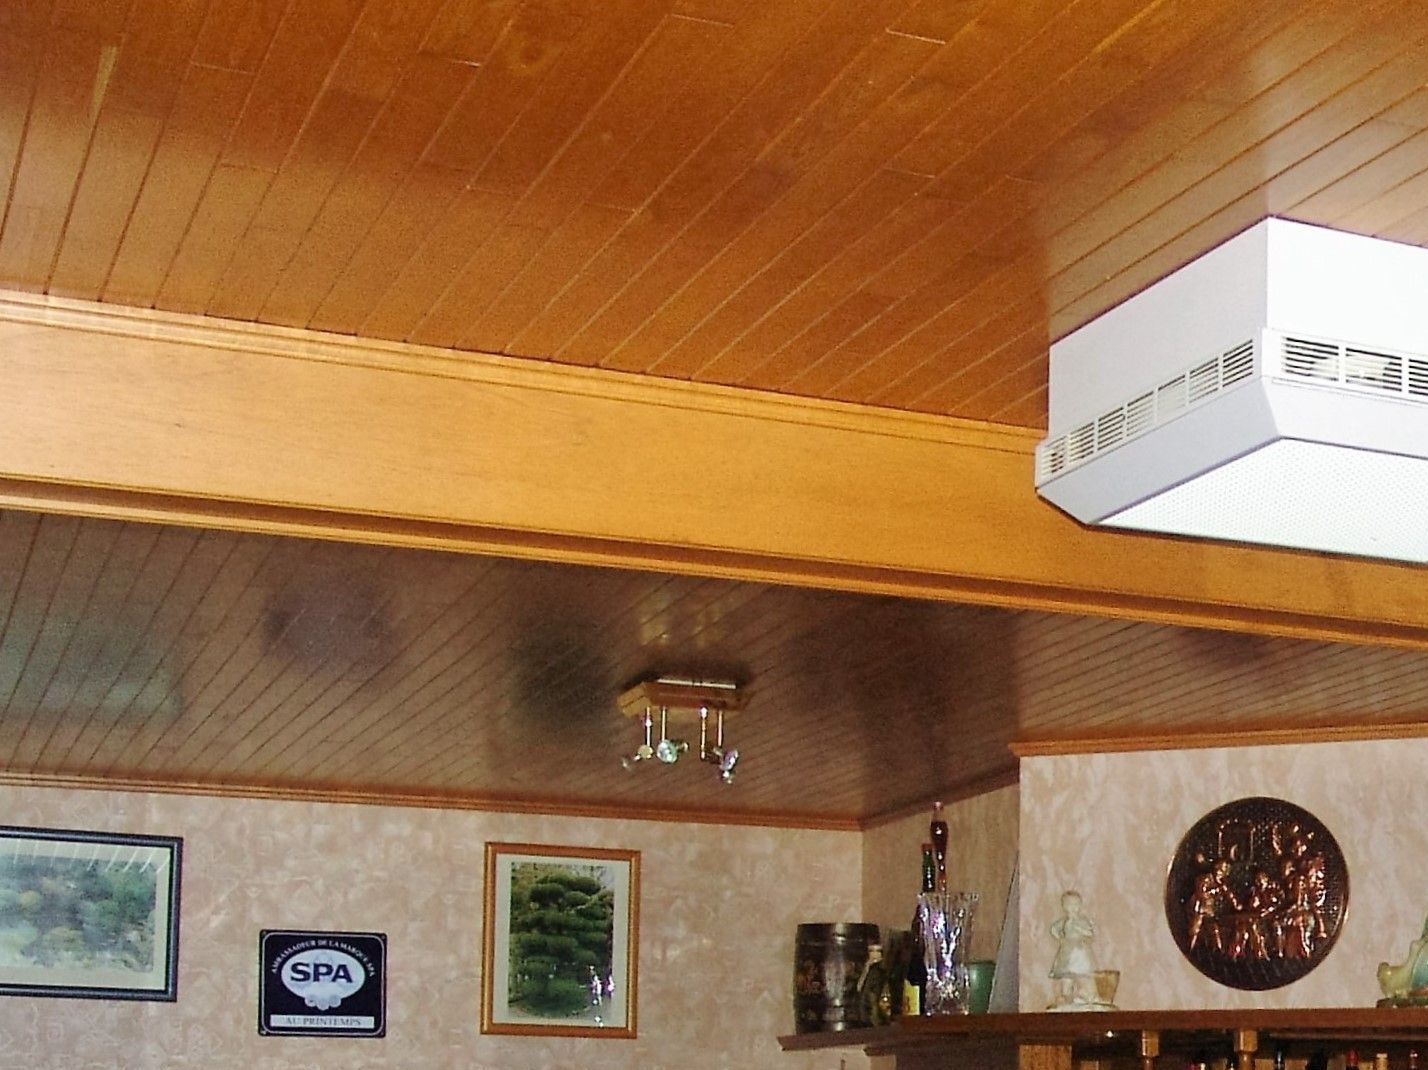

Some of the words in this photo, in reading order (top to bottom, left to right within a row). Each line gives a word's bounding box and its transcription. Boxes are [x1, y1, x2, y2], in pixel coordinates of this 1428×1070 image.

[317, 939, 328, 947] DE
[329, 940, 340, 948] LA
[290, 961, 353, 983] SPA
[303, 1017, 361, 1026] PRINTEMPS
